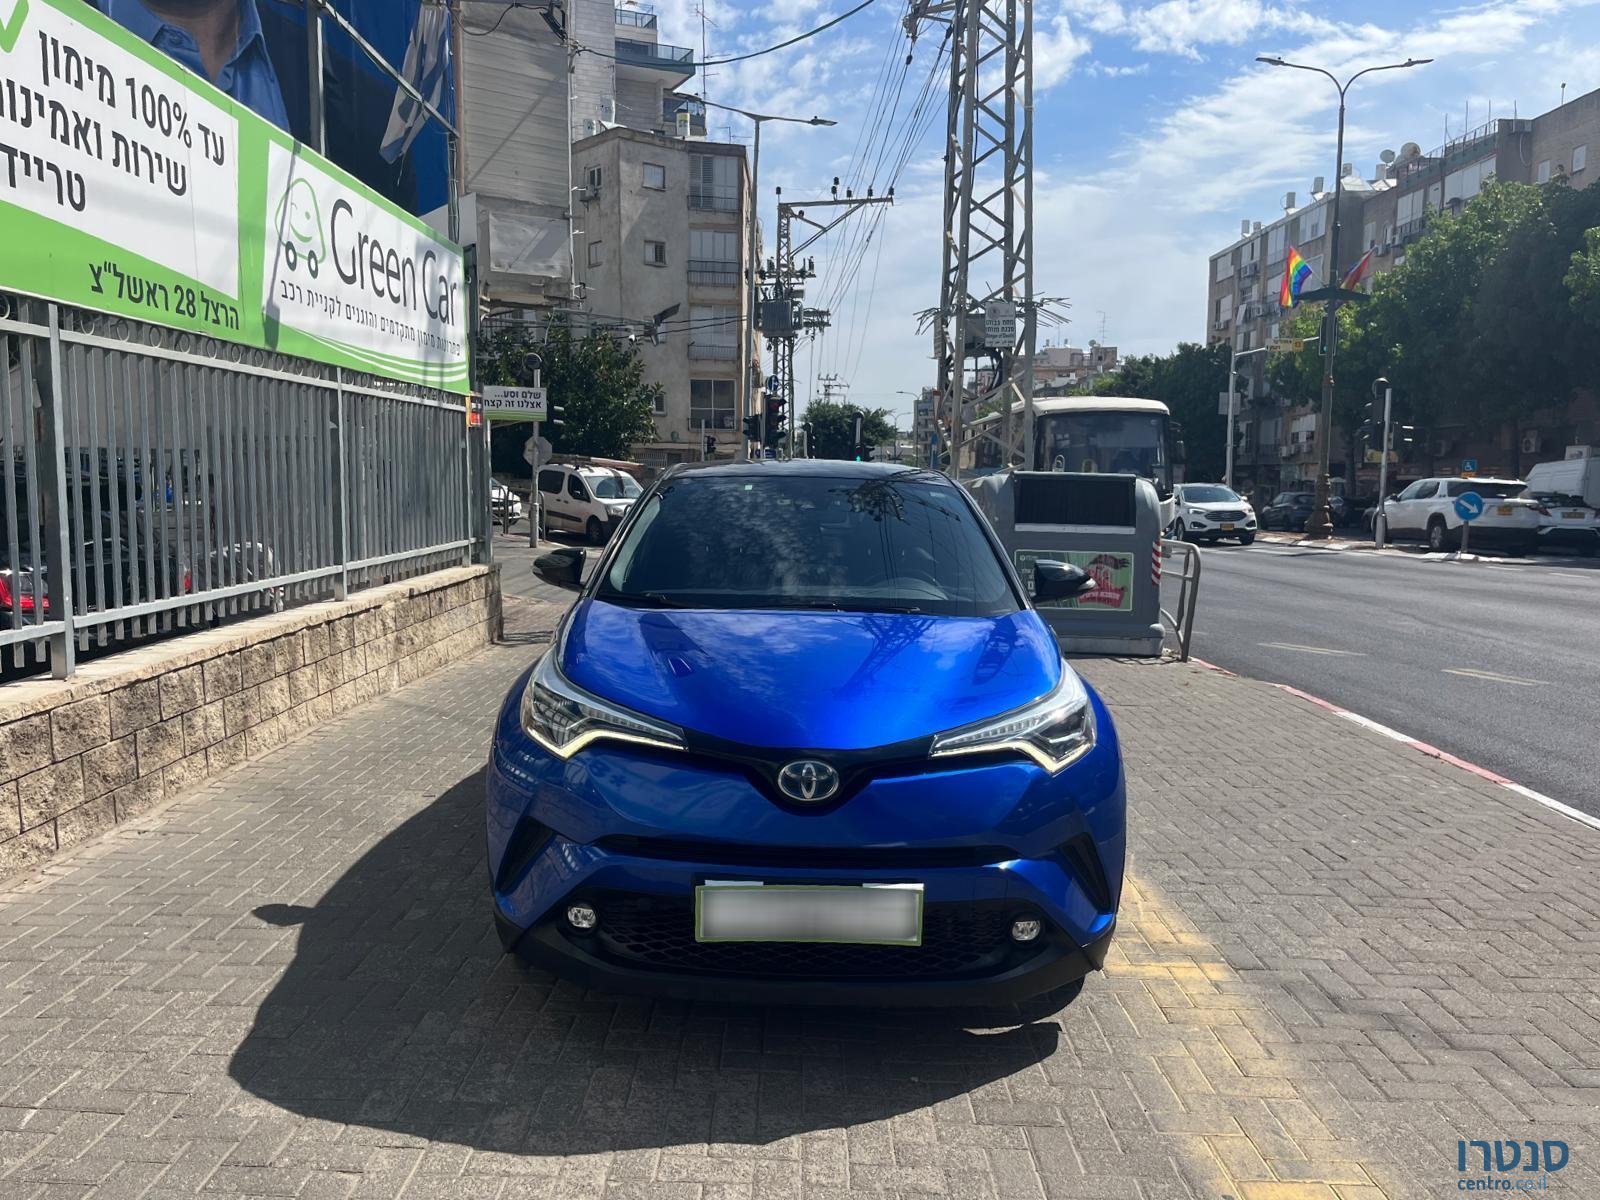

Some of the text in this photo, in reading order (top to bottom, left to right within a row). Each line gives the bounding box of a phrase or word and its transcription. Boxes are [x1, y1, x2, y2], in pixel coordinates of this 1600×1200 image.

[38, 29, 225, 166] עד 100% מימון
[0, 142, 86, 213] טרייד
[111, 129, 187, 197] שירות
[330, 198, 457, 326] Green Car
[173, 284, 197, 319] 28
[280, 279, 303, 304] רכב
[306, 288, 342, 320] לקניית
[200, 290, 240, 331] הרצל
[345, 303, 378, 330] והוגנים
[380, 316, 416, 343] מתקדמים
[504, 400, 515, 408] זה
[516, 400, 542, 409] אצלנו
[521, 390, 541, 400] שלם
